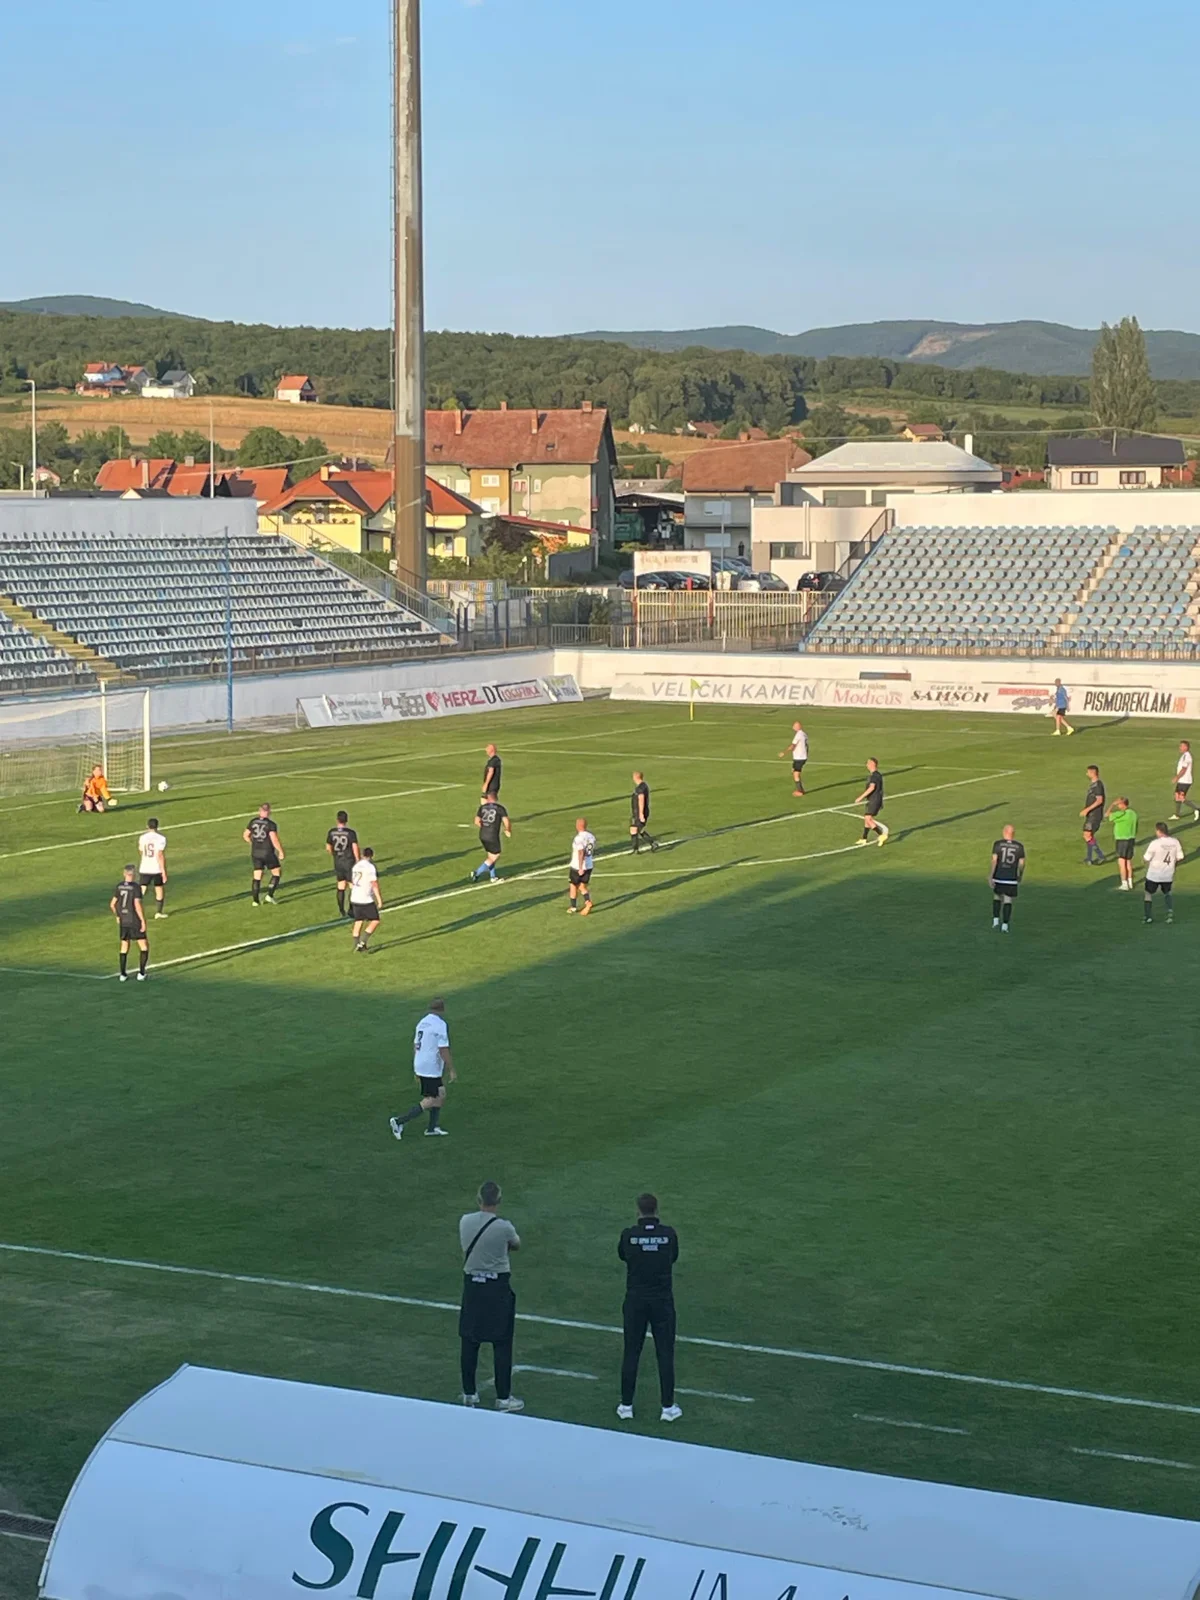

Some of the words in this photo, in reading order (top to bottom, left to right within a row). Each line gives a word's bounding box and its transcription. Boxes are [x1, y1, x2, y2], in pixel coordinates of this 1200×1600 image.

[441, 688, 485, 708] HERZ
[740, 683, 816, 700] KAMEN
[911, 690, 990, 703] SAMSON
[481, 808, 496, 823] 28
[251, 823, 267, 839] 36
[332, 835, 348, 851] 29
[1001, 847, 1017, 864] 15
[1163, 851, 1172, 866] 4
[120, 890, 129, 908] 7
